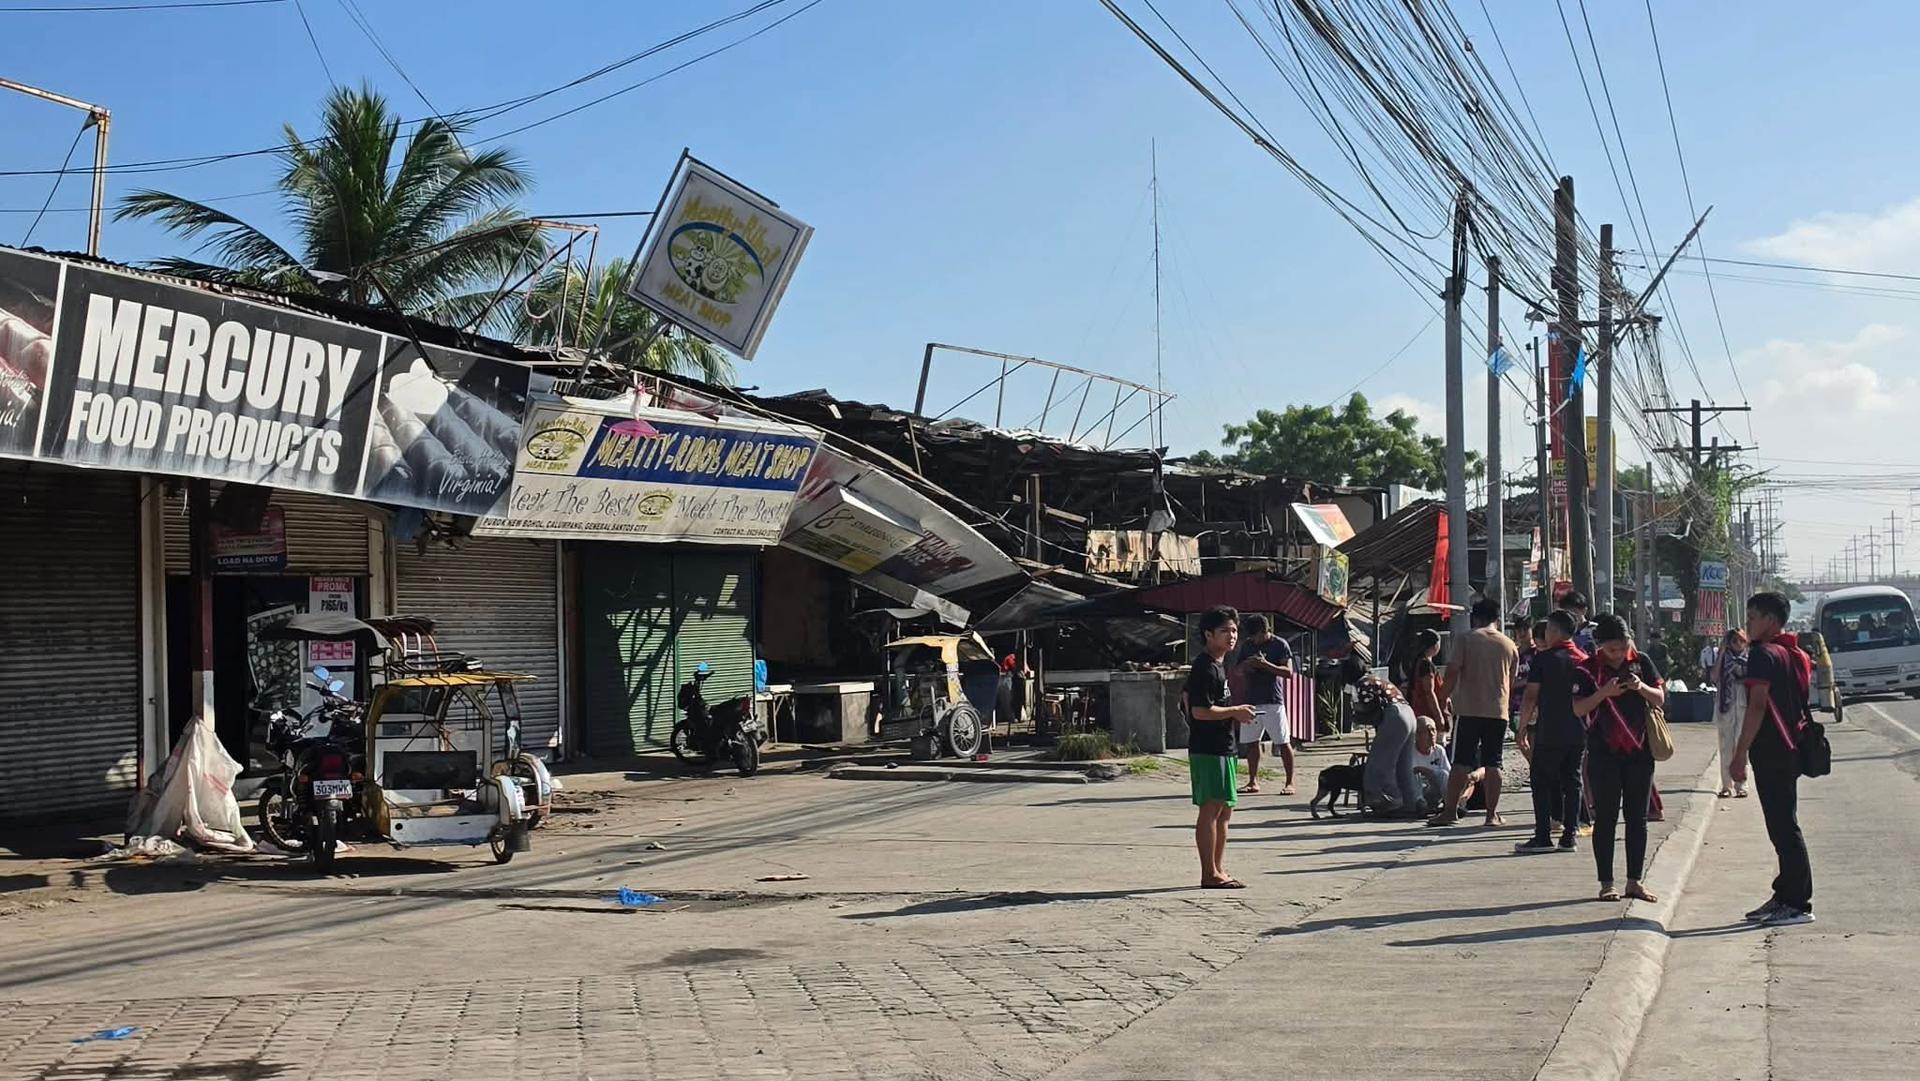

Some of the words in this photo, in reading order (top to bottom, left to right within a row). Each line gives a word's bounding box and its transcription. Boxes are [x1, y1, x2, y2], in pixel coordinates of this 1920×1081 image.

[660, 281, 697, 312] MEAT
[698, 301, 732, 328] SHOP
[78, 293, 362, 422] MERCURY
[67, 389, 163, 449] FOOD
[164, 405, 343, 475] PRODUCTS
[524, 460, 547, 470] MEAT
[547, 462, 568, 471] SHOP
[715, 440, 775, 478] MEAT
[764, 443, 811, 480] SHOP
[439, 466, 503, 503] Virginia!
[553, 482, 588, 515] The
[674, 495, 718, 520] Meet
[720, 494, 748, 522] The
[584, 522, 610, 531] GENERAL
[611, 523, 633, 531] SANTOS
[634, 524, 648, 532] CITY
[217, 557, 240, 565] LOAD
[242, 556, 254, 564] NA
[255, 555, 278, 563] DITO!
[1702, 564, 1725, 580] KCC
